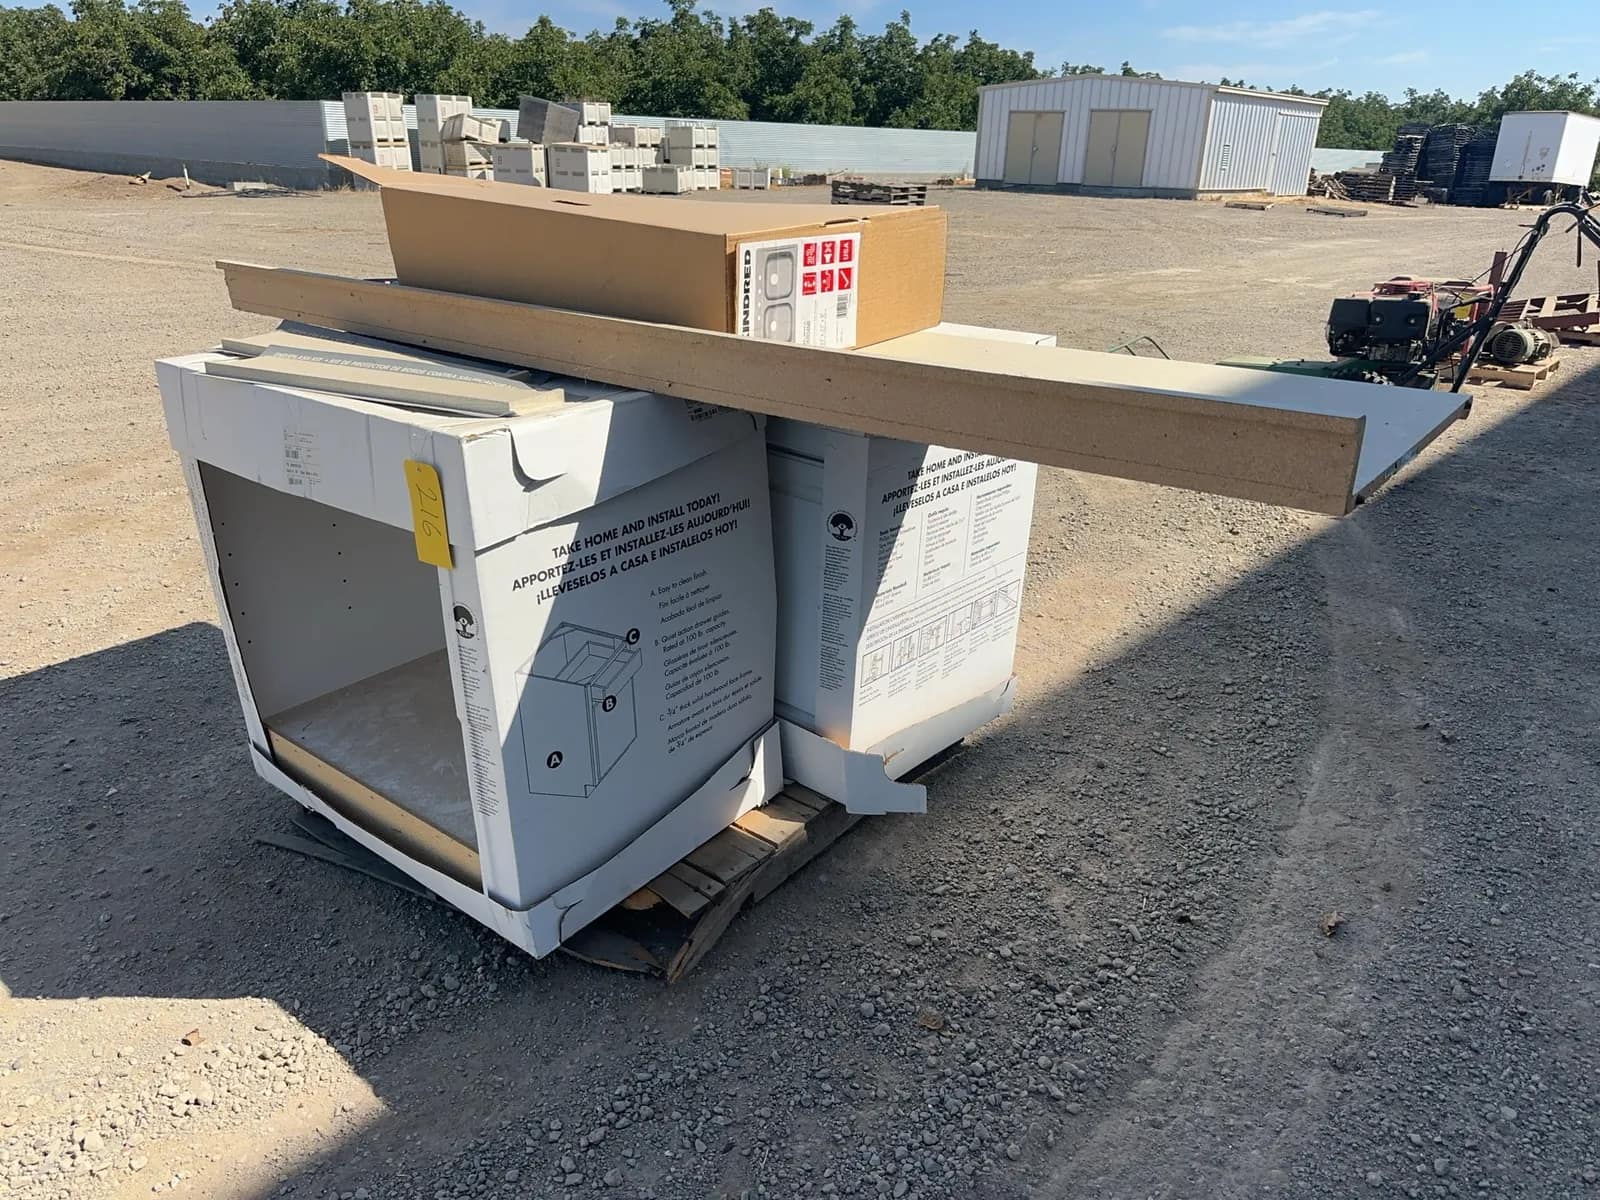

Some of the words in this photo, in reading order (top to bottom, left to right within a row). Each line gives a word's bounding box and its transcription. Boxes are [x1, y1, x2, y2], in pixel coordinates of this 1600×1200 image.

[742, 249, 752, 336] INDRED
[908, 466, 924, 480] TAKE
[925, 459, 946, 473] HOME
[947, 454, 963, 466] AND
[882, 479, 932, 504] APPORTEZ-LES
[932, 477, 940, 486] ET
[941, 461, 985, 483] INSTALLEZ-LES
[935, 491, 941, 499] A
[942, 484, 960, 497] CASA
[960, 481, 965, 490] E
[966, 469, 1001, 489] INSTALELOS
[1001, 463, 1017, 476] HOY!
[416, 483, 441, 537] 216
[552, 541, 582, 560] TAKE
[584, 528, 619, 549] HOME
[621, 519, 645, 537] AND
[647, 506, 686, 527] INSTALL
[686, 492, 721, 513] TODAY!
[512, 551, 598, 592] APPORTEZ-LES
[600, 548, 612, 561] ET
[615, 523, 685, 557] INSTALLEZ-LES
[686, 498, 751, 530] AUJOURD'HUI!
[536, 568, 607, 605] ¡LLEVESELOS
[609, 564, 618, 576] A
[620, 556, 649, 573] CASA
[651, 550, 657, 561] E
[659, 530, 714, 558] INSTALELOS
[715, 519, 738, 537] HOY!
[658, 585, 671, 594] Easy
[678, 577, 693, 586] clean
[697, 600, 705, 608] de
[661, 632, 677, 643] Quiet
[677, 625, 694, 636] action
[694, 617, 712, 629] drawer
[663, 640, 679, 652] Rated
[679, 638, 685, 646] at
[686, 632, 697, 642] 100
[714, 643, 725, 653] 100
[703, 671, 714, 680] 100
[549, 754, 561, 768] A
